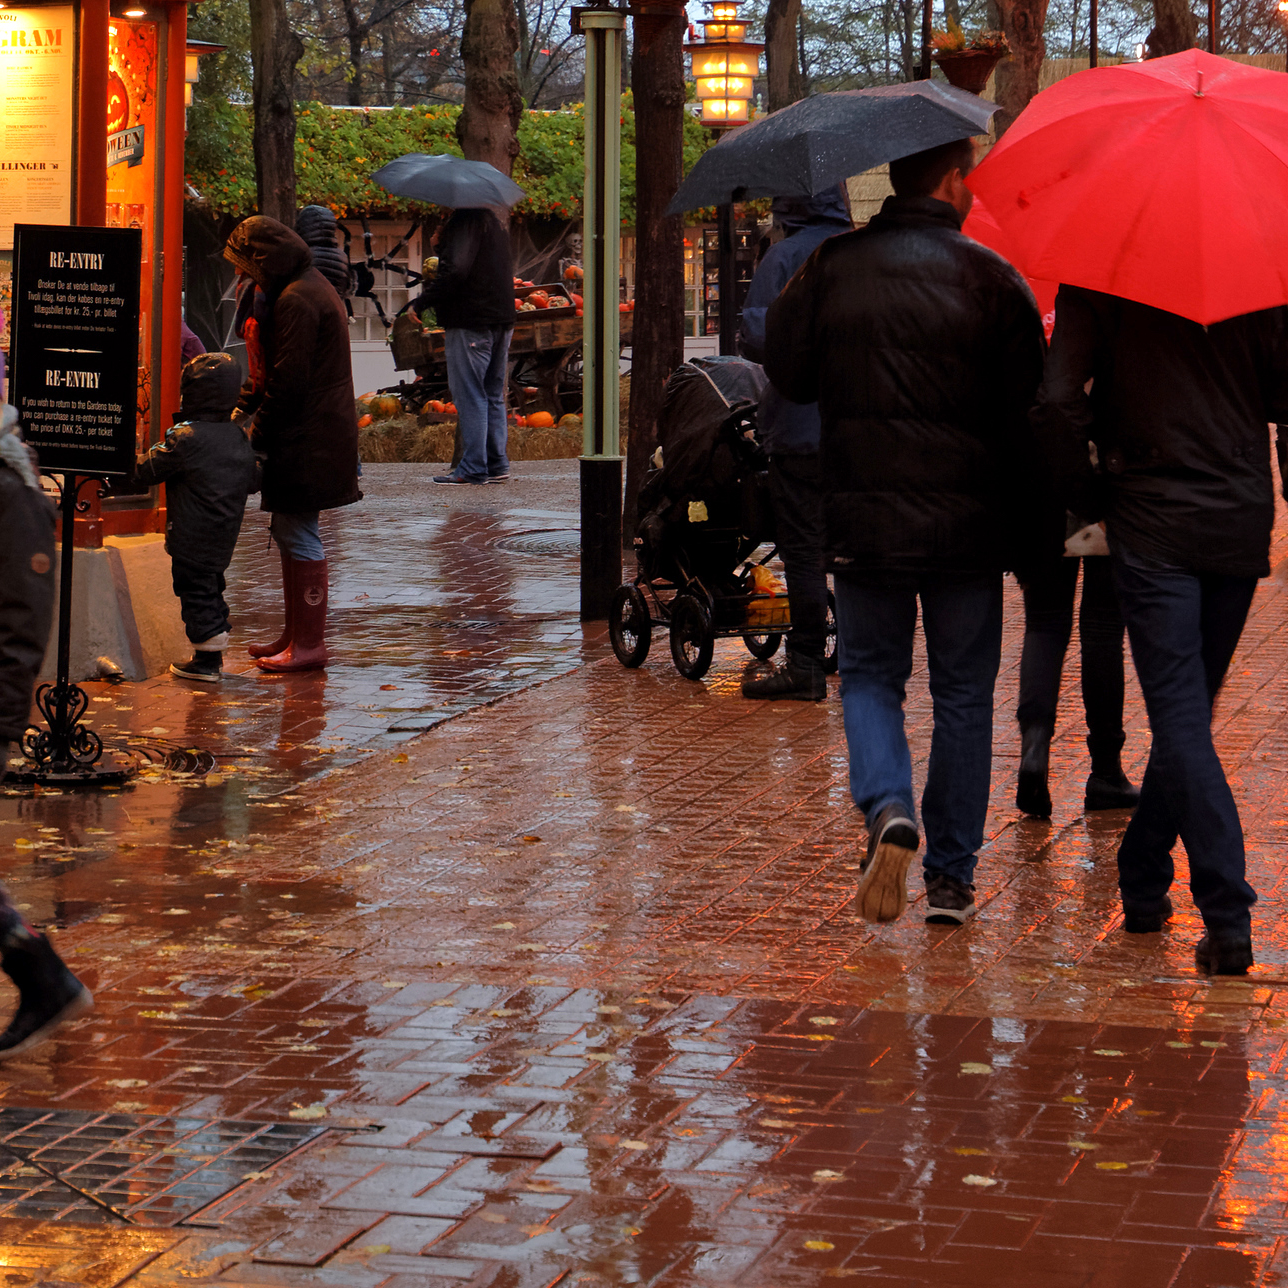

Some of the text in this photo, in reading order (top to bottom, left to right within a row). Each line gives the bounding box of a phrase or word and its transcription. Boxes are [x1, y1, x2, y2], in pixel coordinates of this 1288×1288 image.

[49, 251, 104, 270] RE-ENTRY
[57, 280, 65, 290] De
[66, 282, 72, 290] at
[73, 282, 89, 291] vende
[90, 282, 108, 293] tilbage
[28, 291, 41, 300] Tivoli
[56, 293, 66, 302] kan
[67, 294, 76, 303] der
[103, 297, 125, 307] re-entry
[103, 308, 117, 318] billet
[45, 369, 101, 389] RE-ENTRY
[22, 396, 27, 405] If
[27, 399, 36, 407] you
[37, 398, 48, 407] wish
[50, 399, 55, 408] to
[56, 400, 70, 408] return
[71, 400, 76, 409] to
[78, 400, 86, 409] the
[87, 400, 107, 411] Gardens
[22, 411, 32, 420] you
[45, 411, 69, 421] purchase
[70, 414, 74, 422] a
[75, 414, 97, 424] re-entry
[98, 415, 113, 424] ticket
[114, 415, 122, 424] for
[31, 422, 39, 431] the
[40, 424, 53, 433] price
[55, 424, 61, 432] of
[62, 424, 74, 434] DKK
[88, 427, 97, 437] per
[98, 427, 113, 437] ticket
